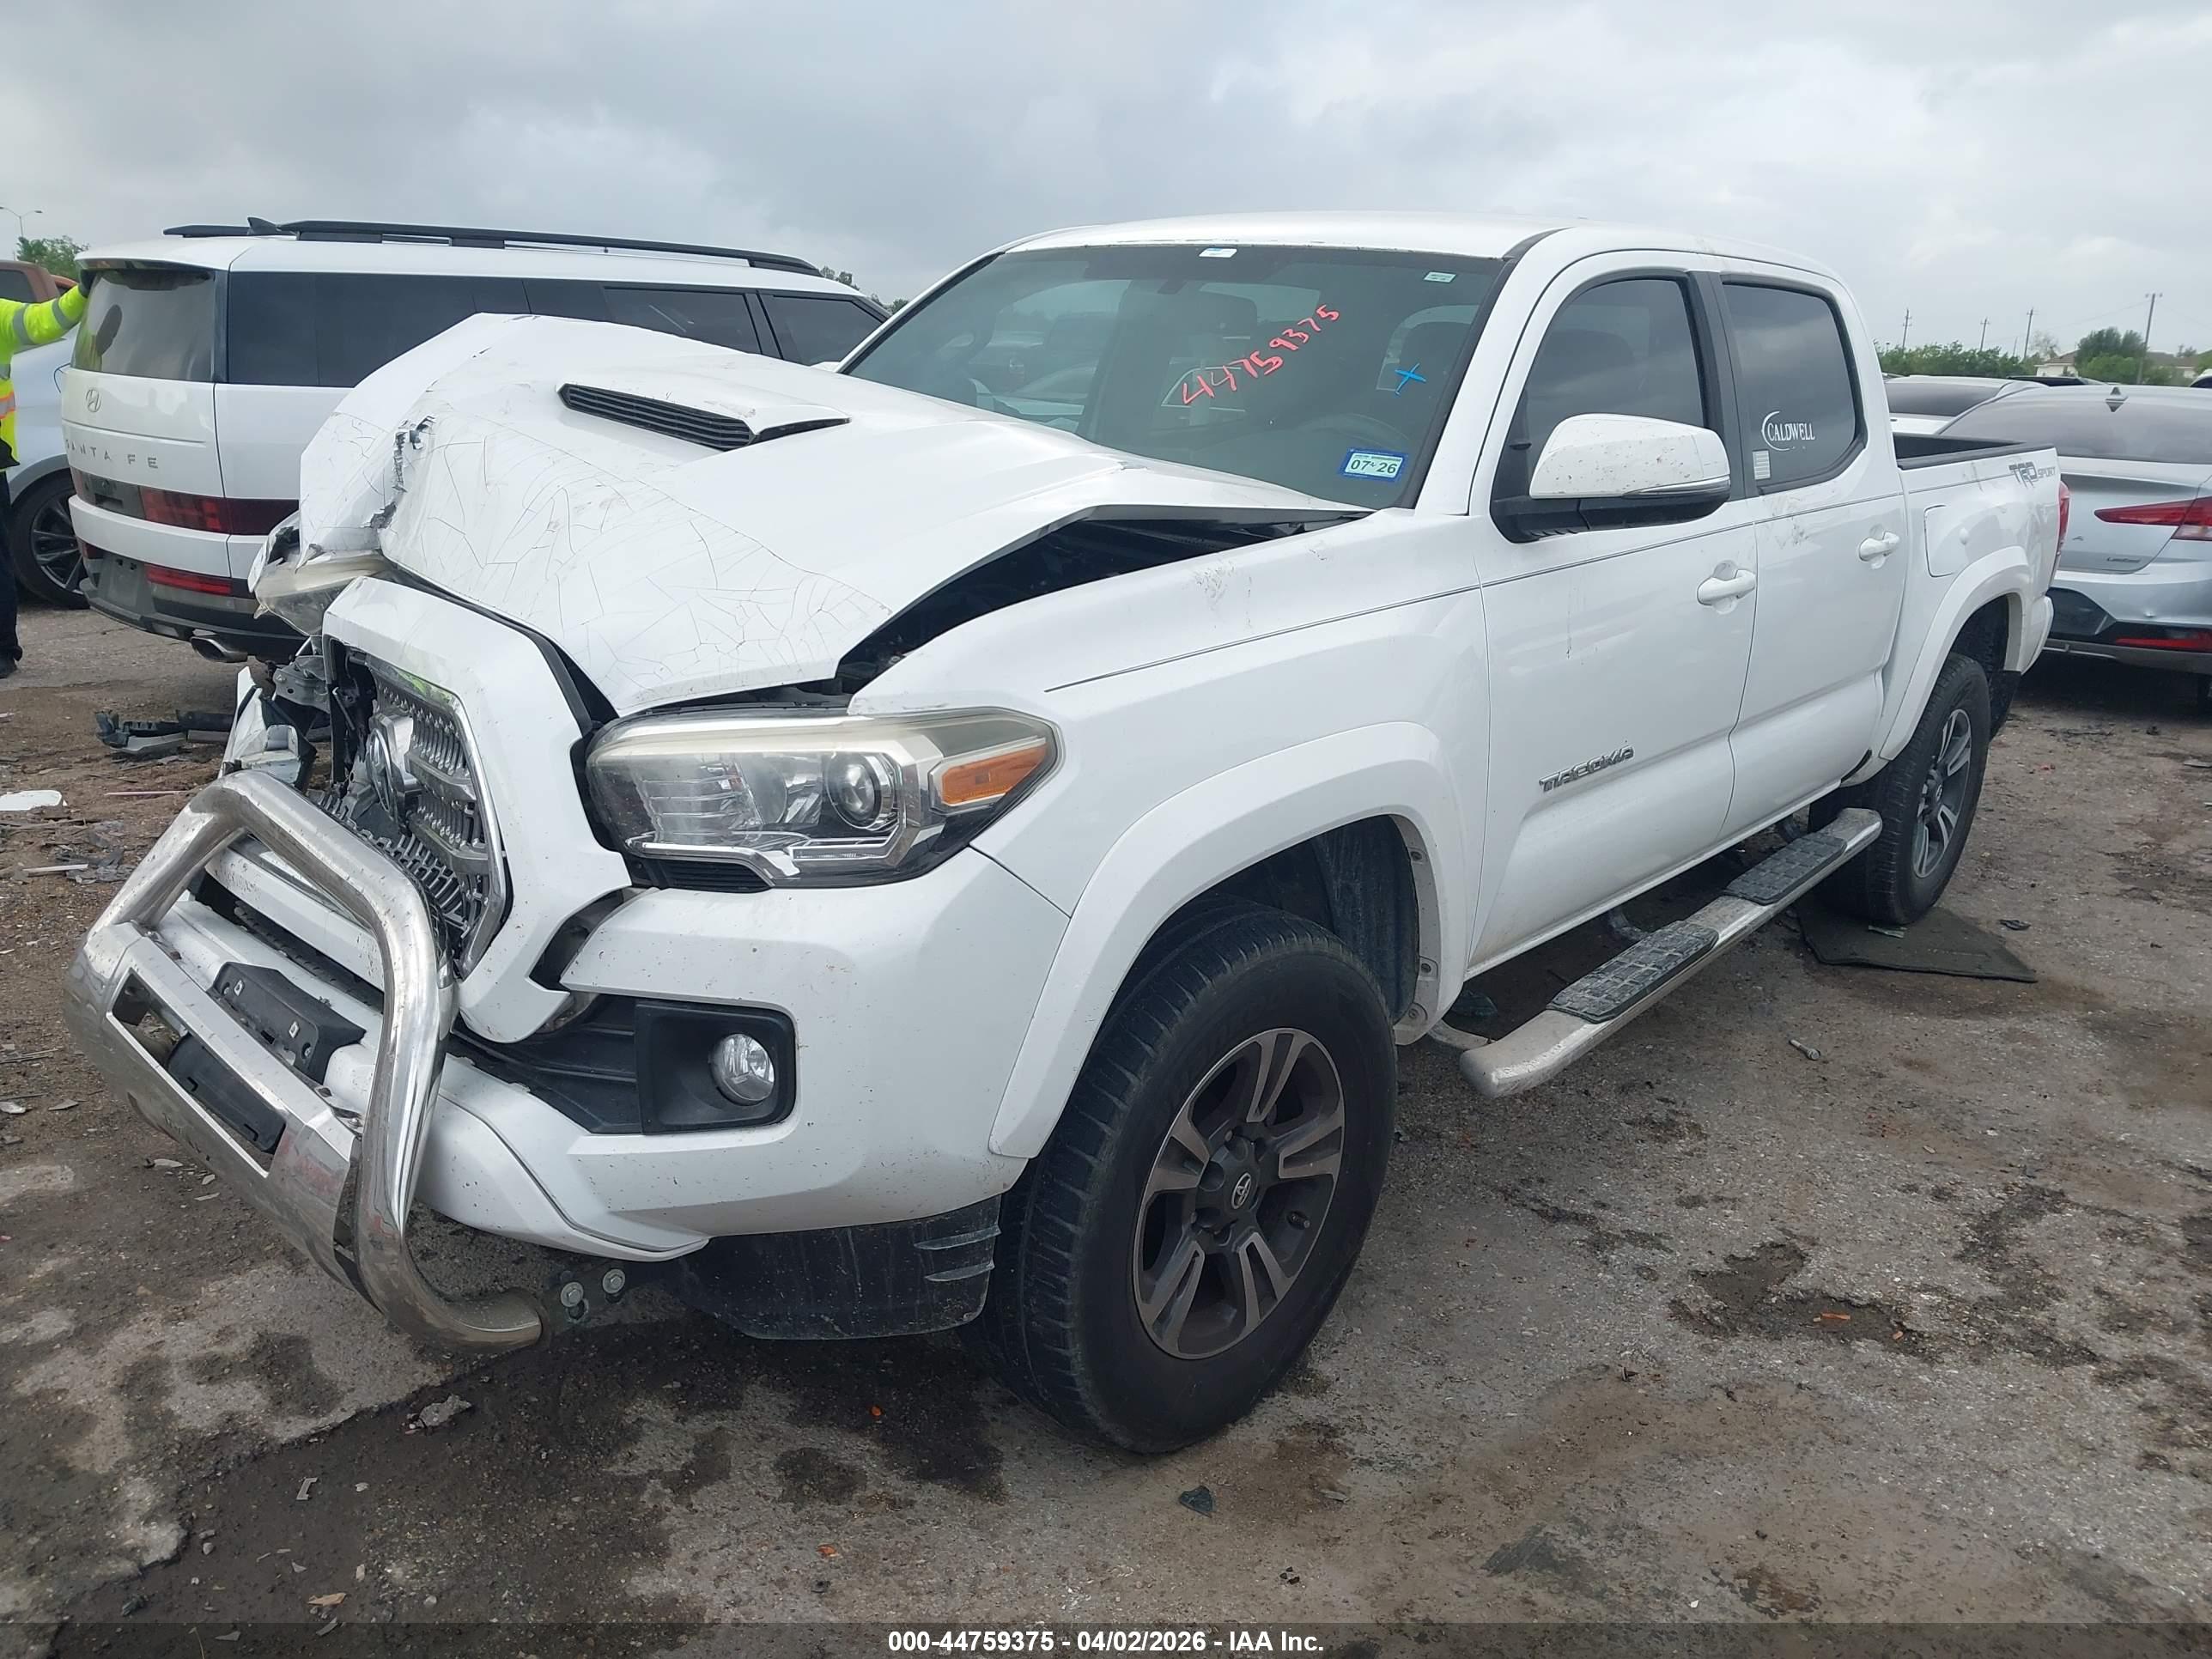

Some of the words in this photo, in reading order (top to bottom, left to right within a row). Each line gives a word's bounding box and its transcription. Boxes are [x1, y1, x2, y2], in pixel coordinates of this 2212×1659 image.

[1182, 304, 1340, 405] 44759375
[1767, 422, 1815, 441] CALDWELL
[127, 453, 158, 469] FE
[1350, 459, 1371, 471] 07
[1376, 462, 1398, 474] 26
[2008, 461, 2038, 489] TRD
[1538, 744, 1635, 793] TACOMA
